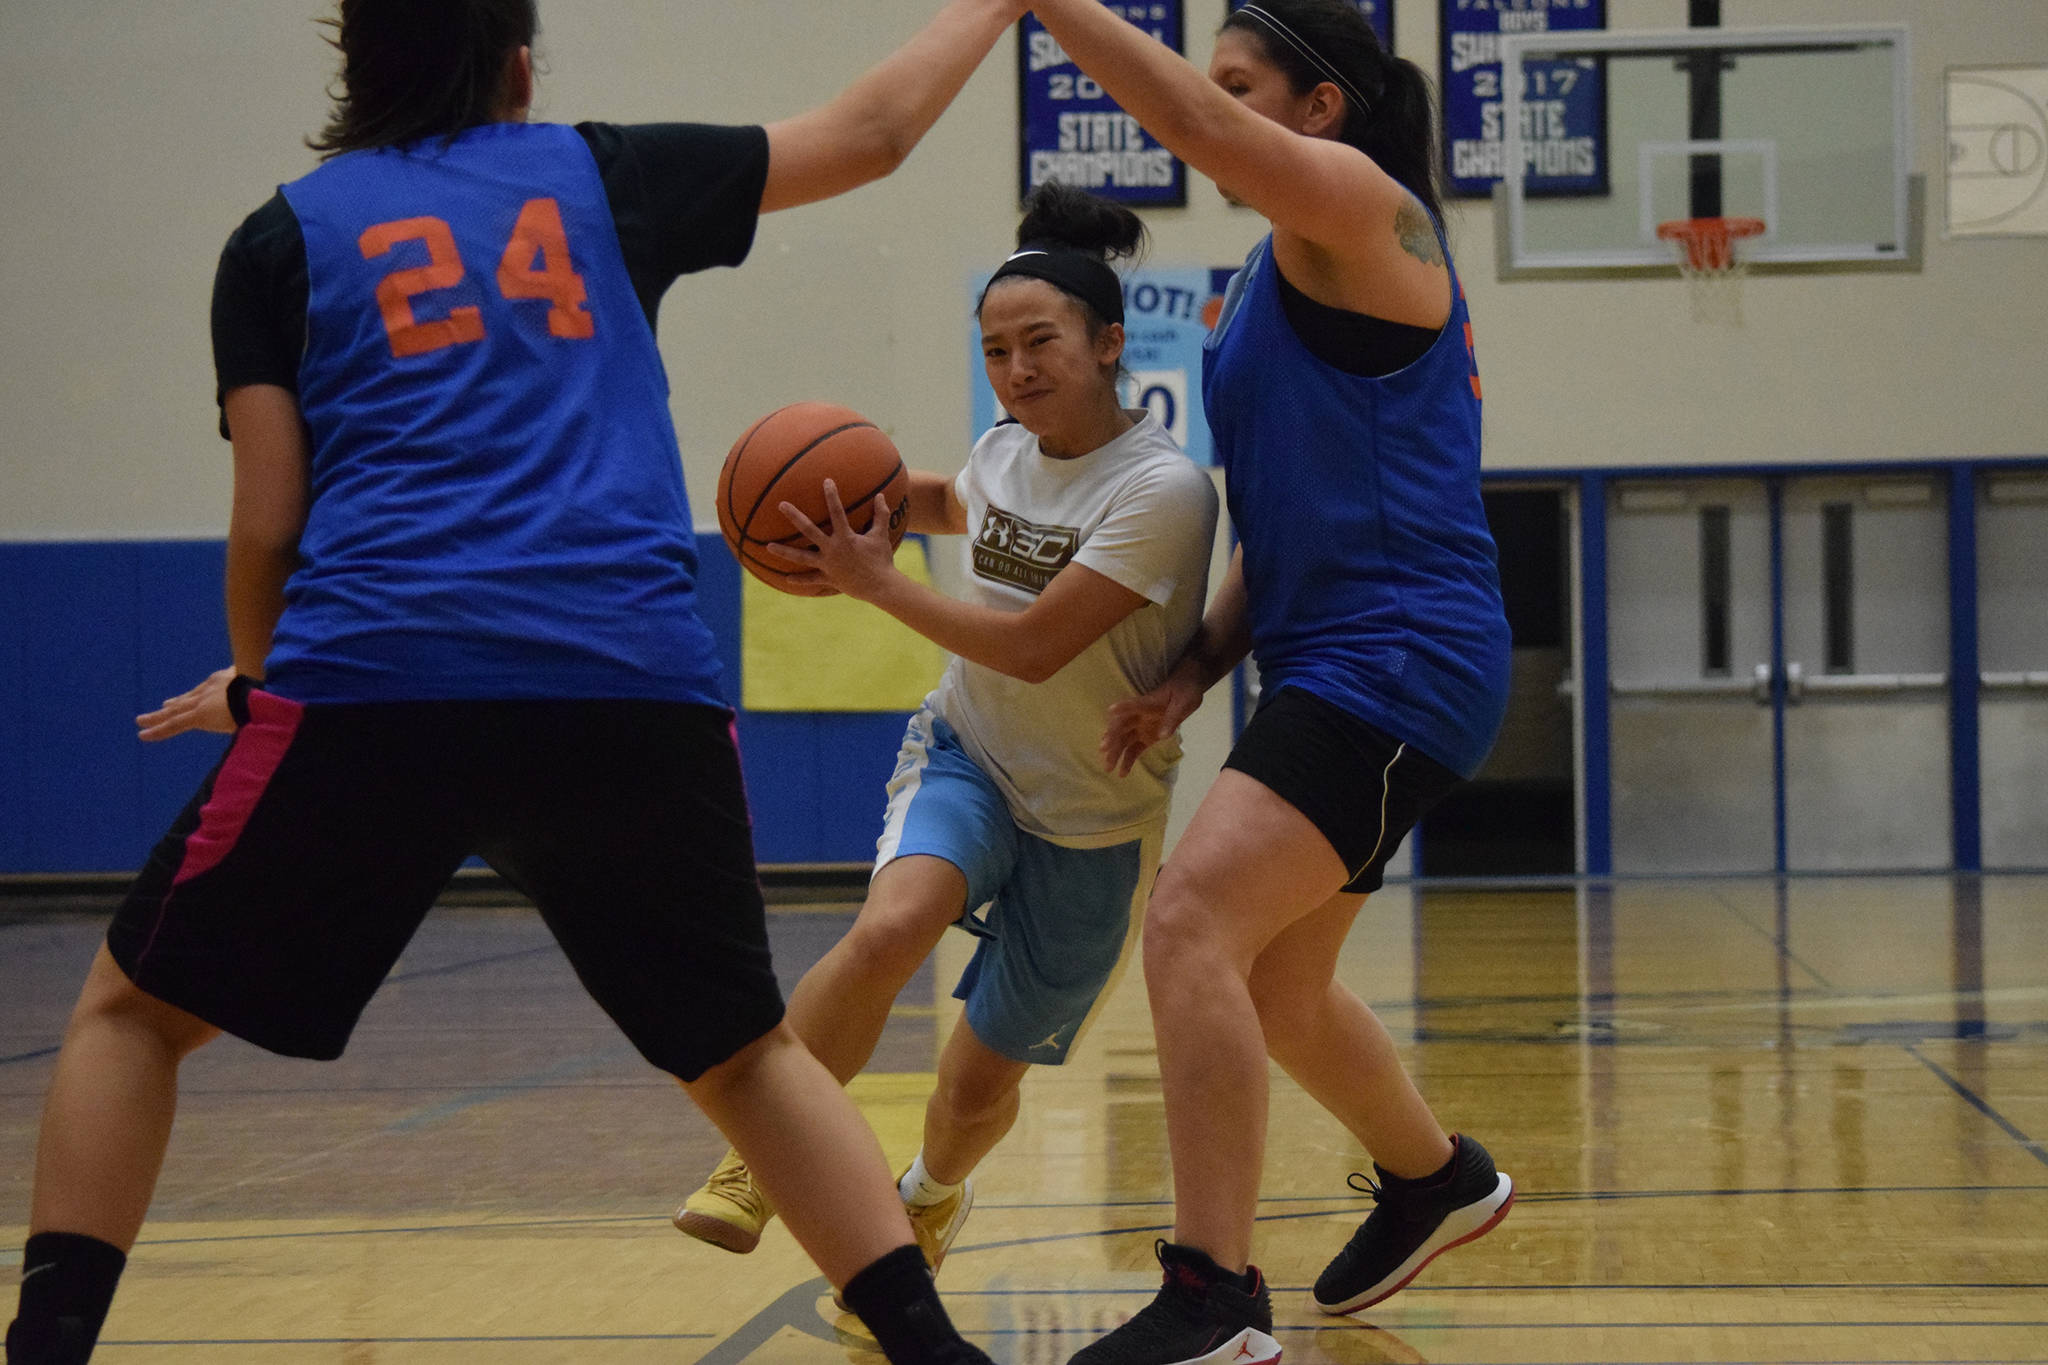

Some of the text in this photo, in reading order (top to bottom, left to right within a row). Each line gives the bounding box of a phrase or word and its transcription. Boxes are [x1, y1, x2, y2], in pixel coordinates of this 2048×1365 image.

[1048, 73, 1103, 100] 20
[1472, 69, 1578, 97] 217
[1058, 112, 1144, 151] STATE
[1481, 101, 1567, 140] SATE
[1030, 148, 1174, 188] CHAMPIONS
[1453, 136, 1596, 178] CHAPIONS
[358, 197, 595, 358] 24
